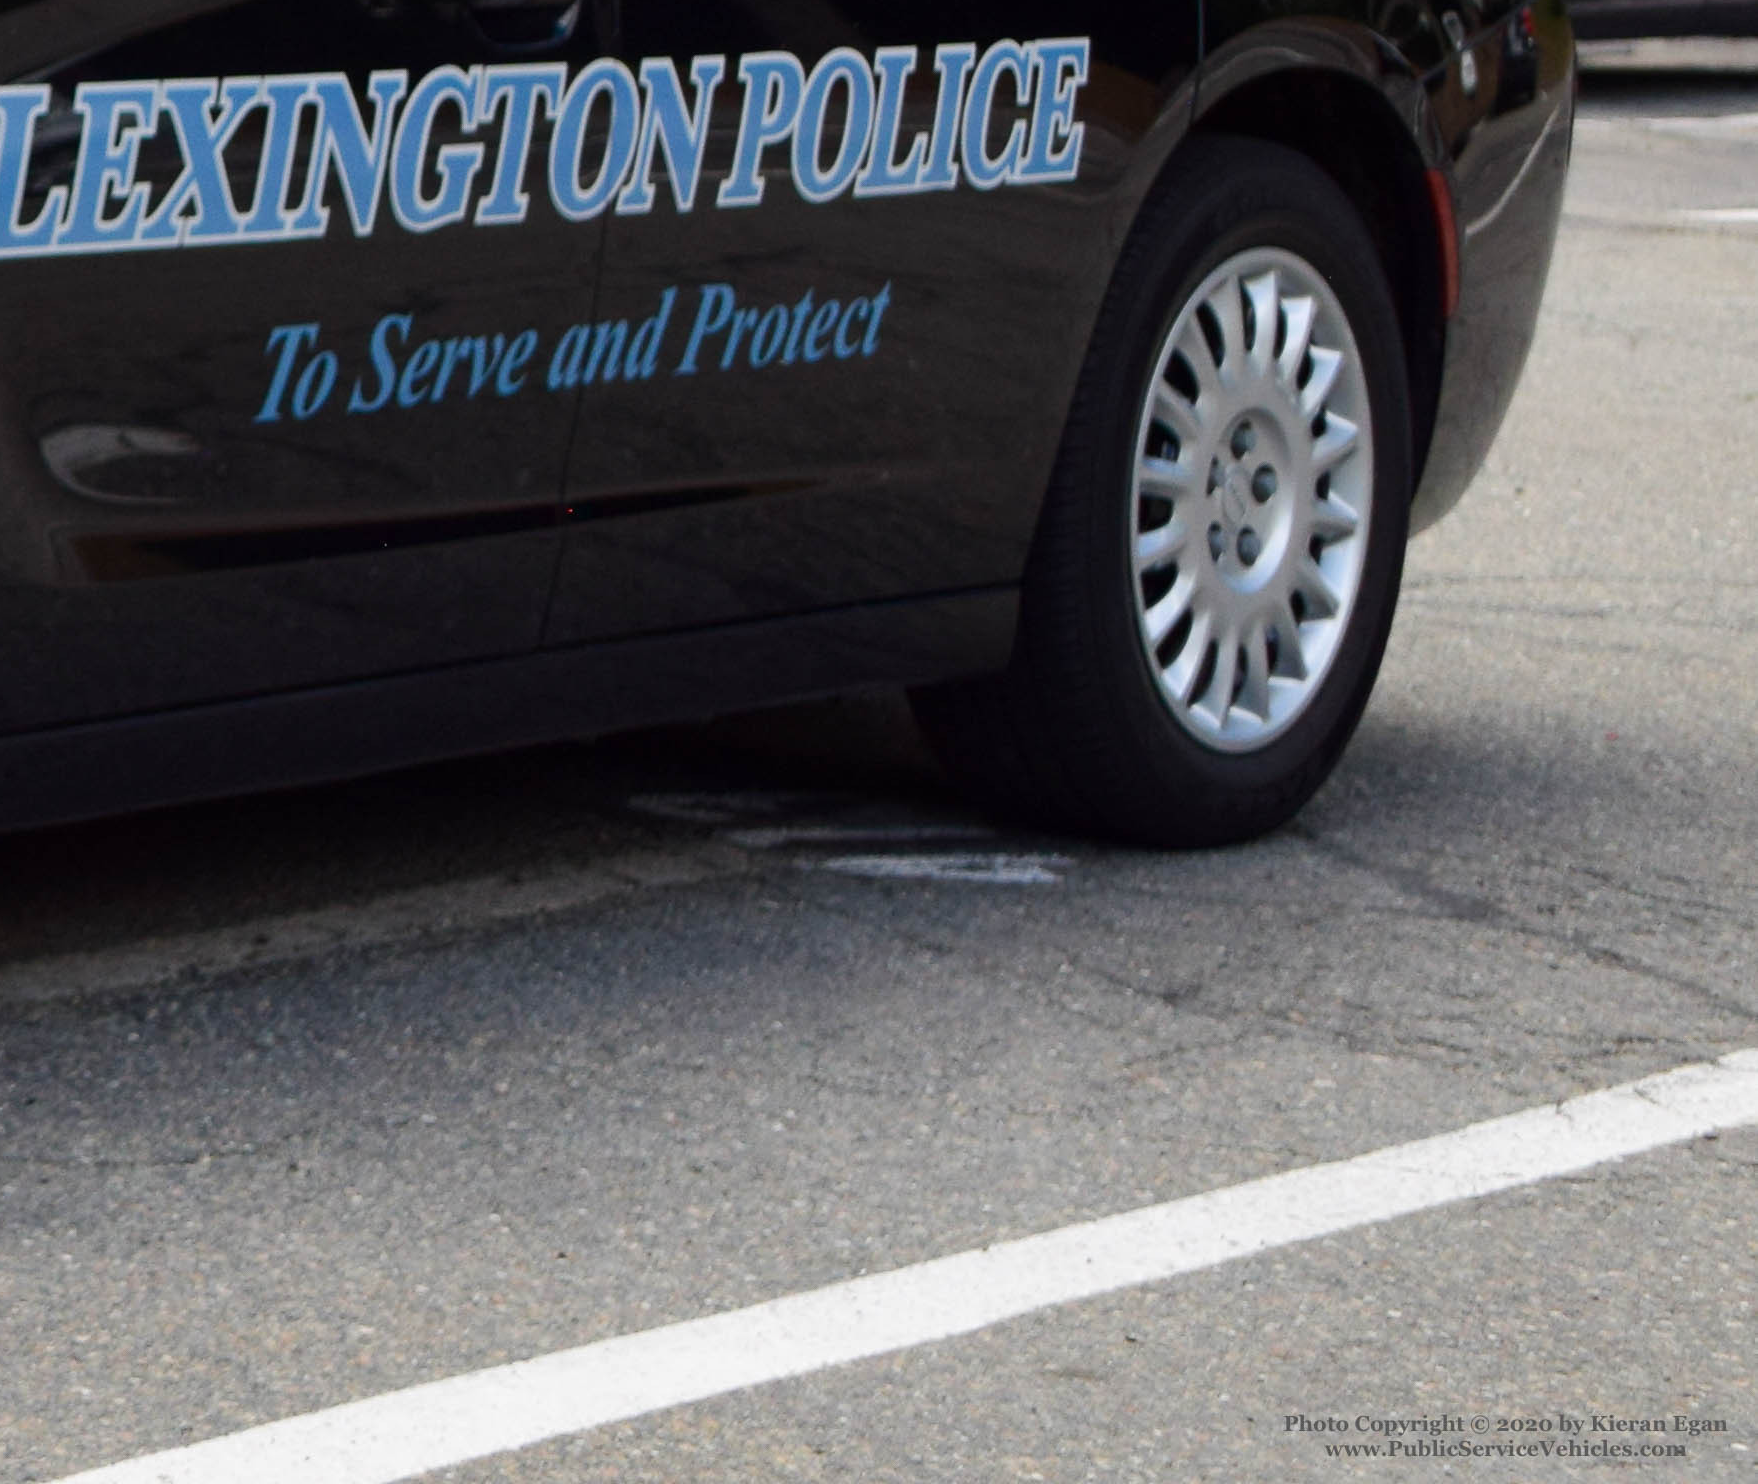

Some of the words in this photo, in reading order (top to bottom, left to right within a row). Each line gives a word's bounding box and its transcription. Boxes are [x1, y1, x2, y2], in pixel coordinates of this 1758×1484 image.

[716, 36, 1091, 208] POLICE
[252, 322, 339, 423] To
[347, 311, 539, 412] Serve
[546, 285, 679, 391] and
[673, 279, 893, 378] Protect
